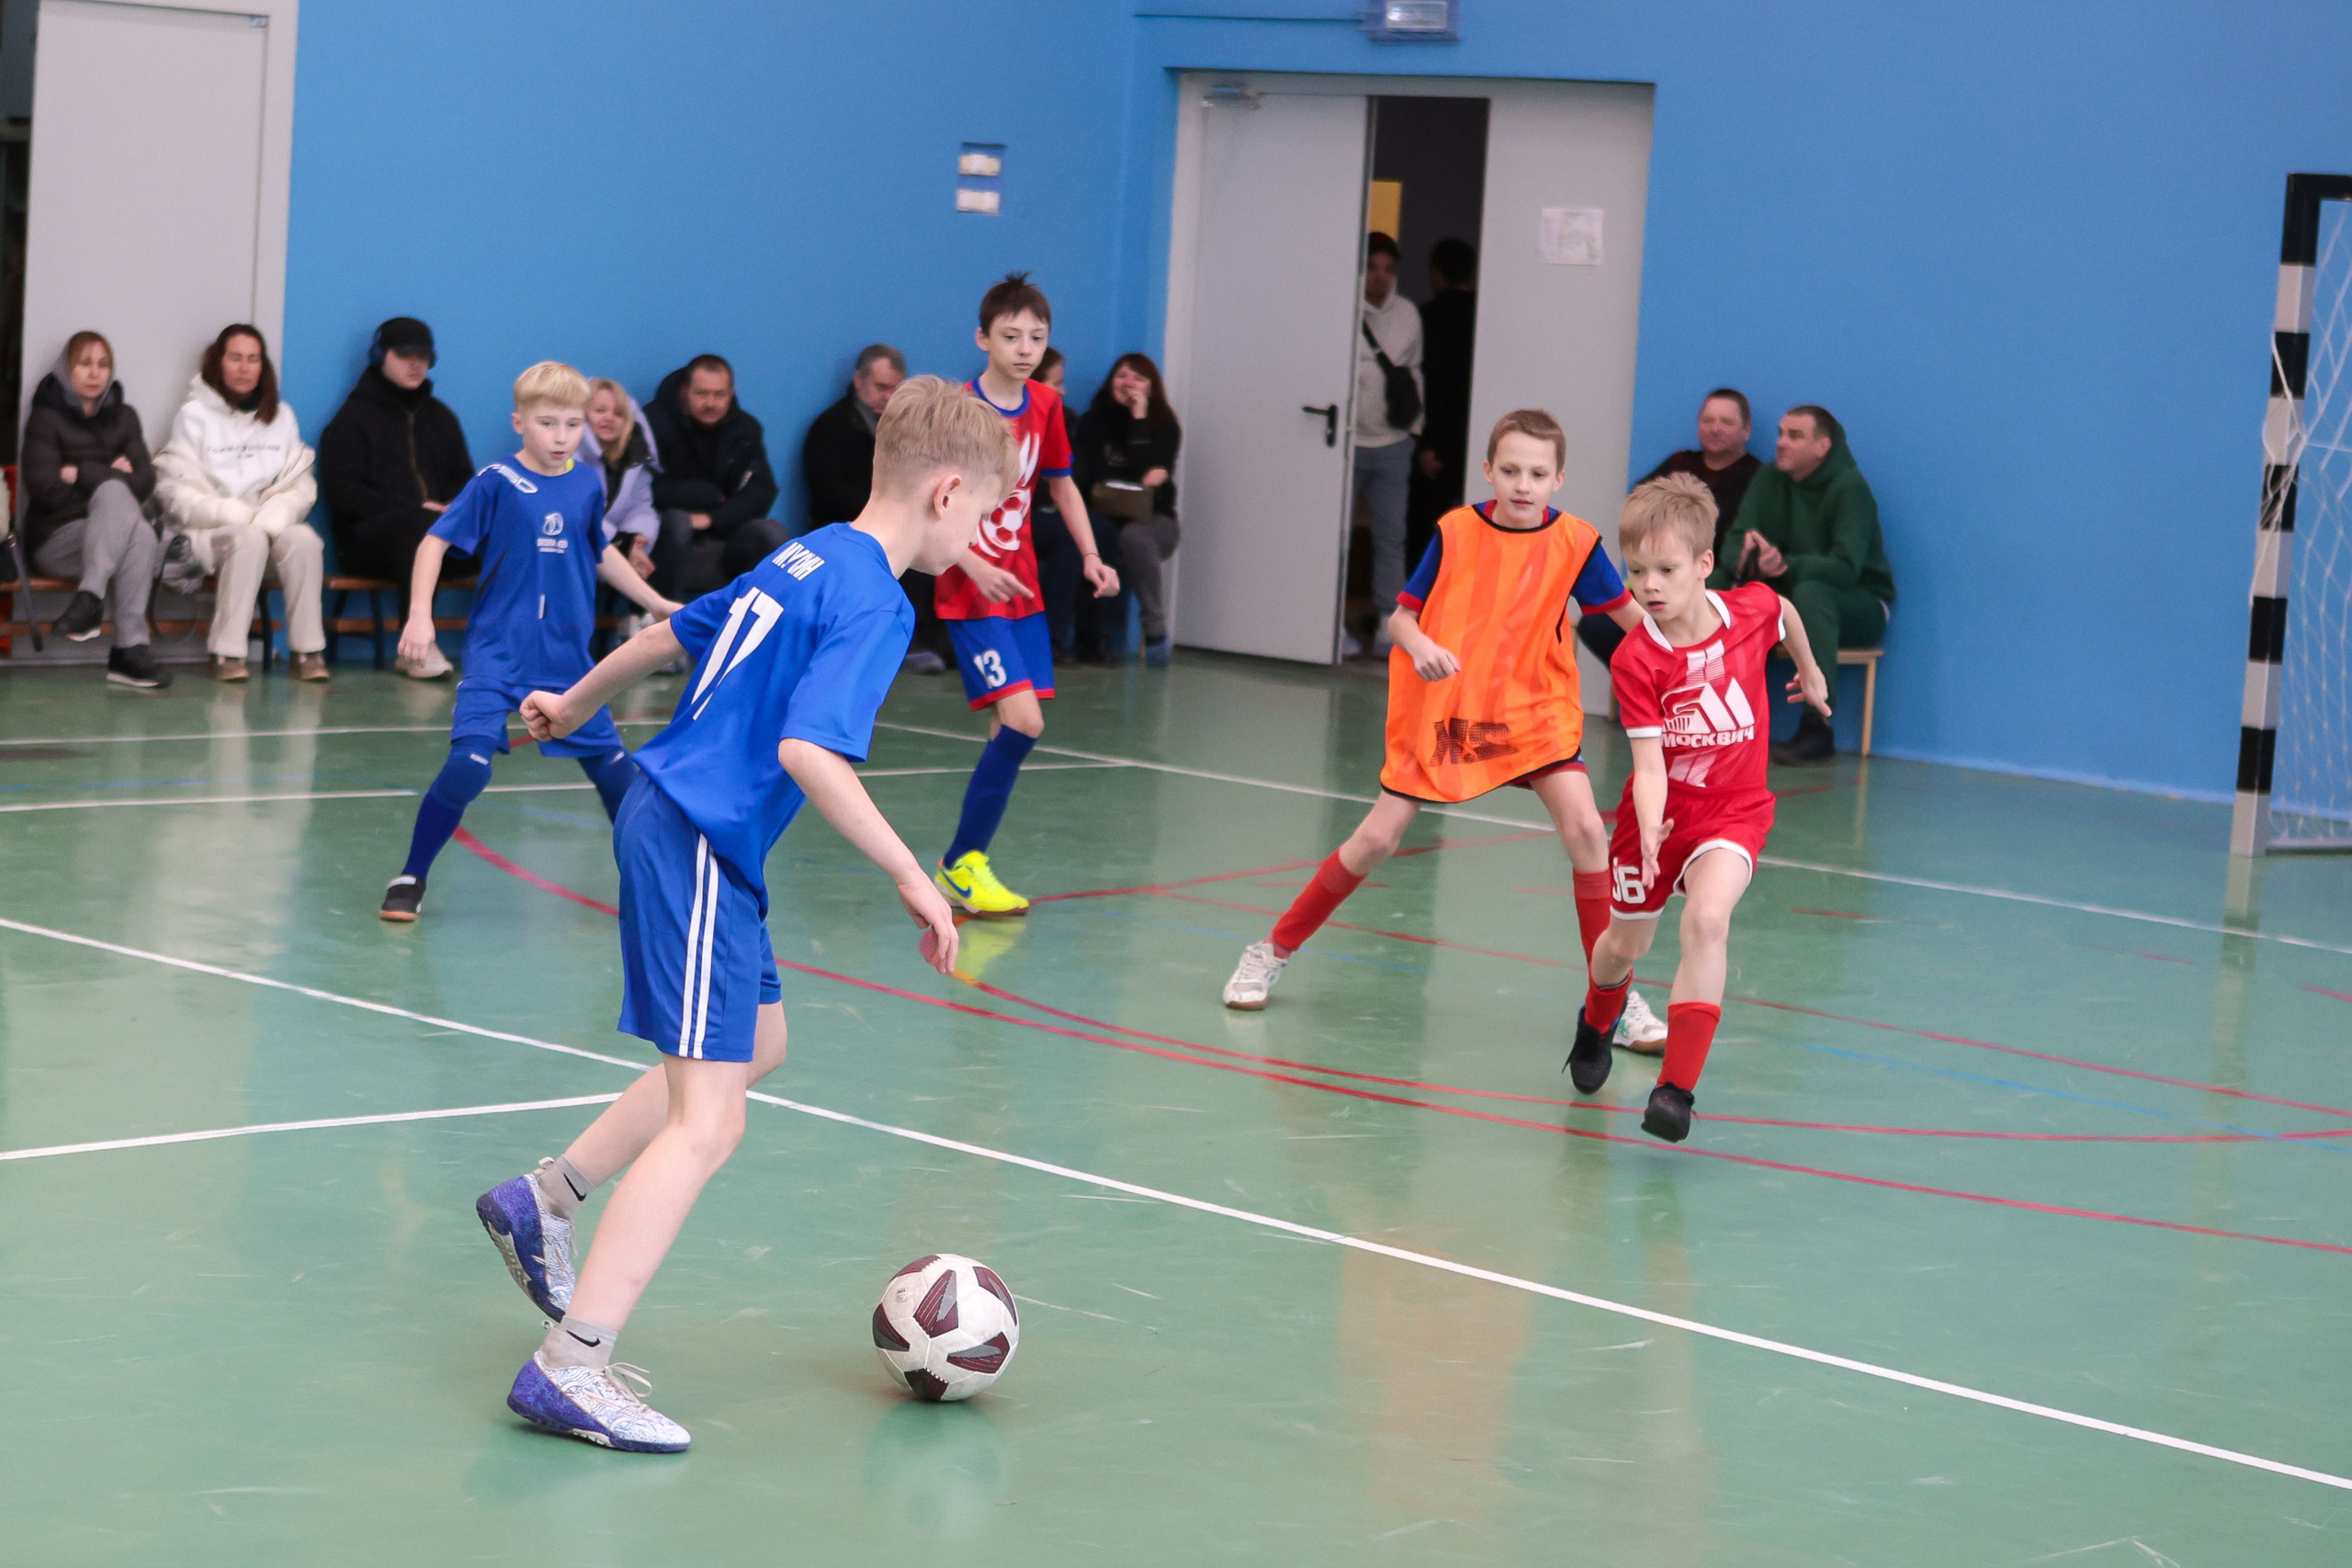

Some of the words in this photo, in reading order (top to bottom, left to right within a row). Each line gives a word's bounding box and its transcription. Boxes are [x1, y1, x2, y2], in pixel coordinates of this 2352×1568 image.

[691, 586, 784, 721] 17
[975, 650, 1007, 689] 13
[1662, 726, 1755, 748] МОСКВИЧ
